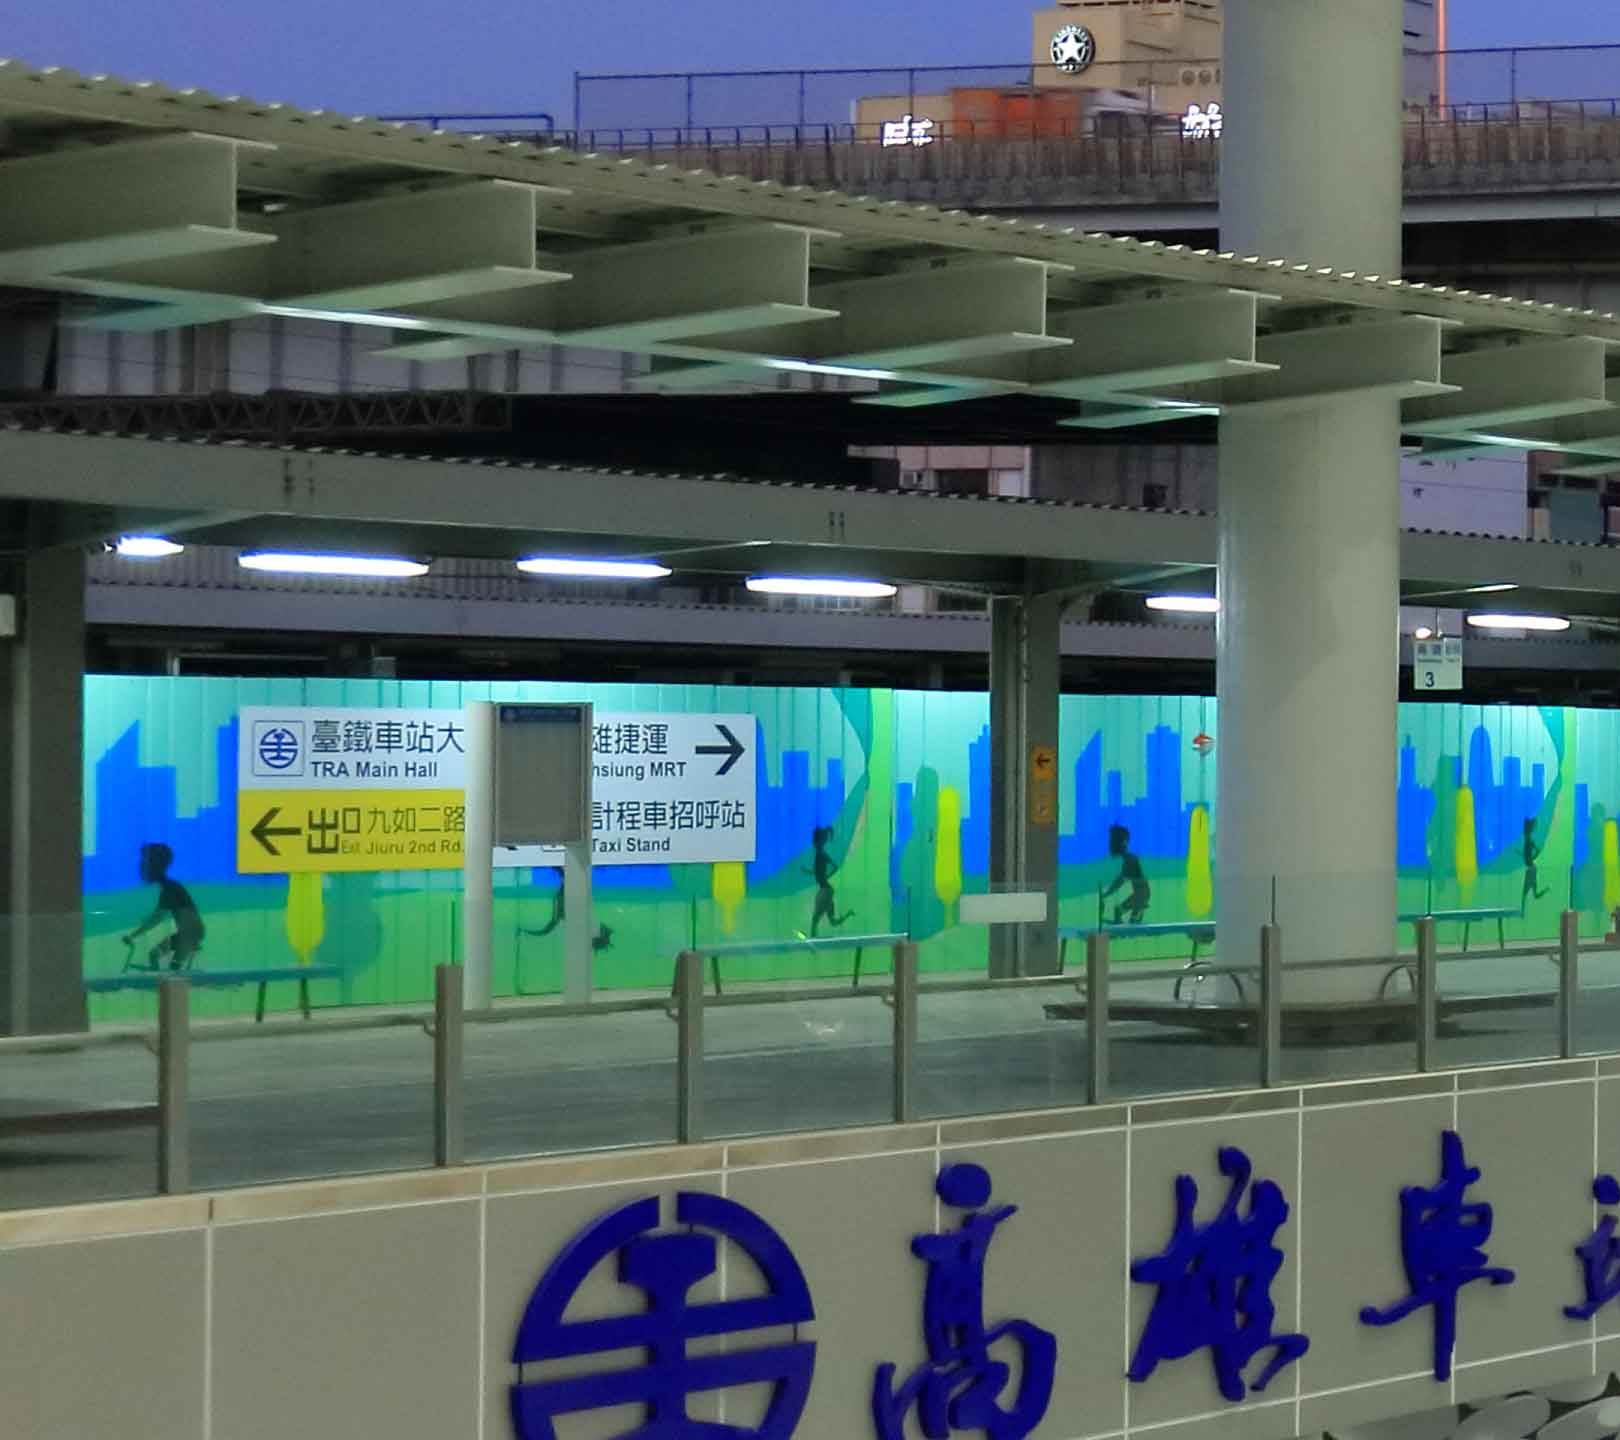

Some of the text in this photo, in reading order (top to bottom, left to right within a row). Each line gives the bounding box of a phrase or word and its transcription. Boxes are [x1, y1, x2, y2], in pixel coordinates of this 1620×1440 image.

[1425, 671, 1434, 688] 3
[311, 720, 464, 754] 臺鐵車站大
[311, 761, 437, 777] TRA Main Hall
[650, 762, 687, 777] MRT
[592, 800, 745, 831] 計程車招呼站
[307, 806, 465, 854] 出口 九如二路
[367, 840, 404, 855] Jiuru
[408, 839, 436, 854] 2nd
[440, 839, 465, 853] Rd.
[592, 837, 670, 853] Taxi Stand
